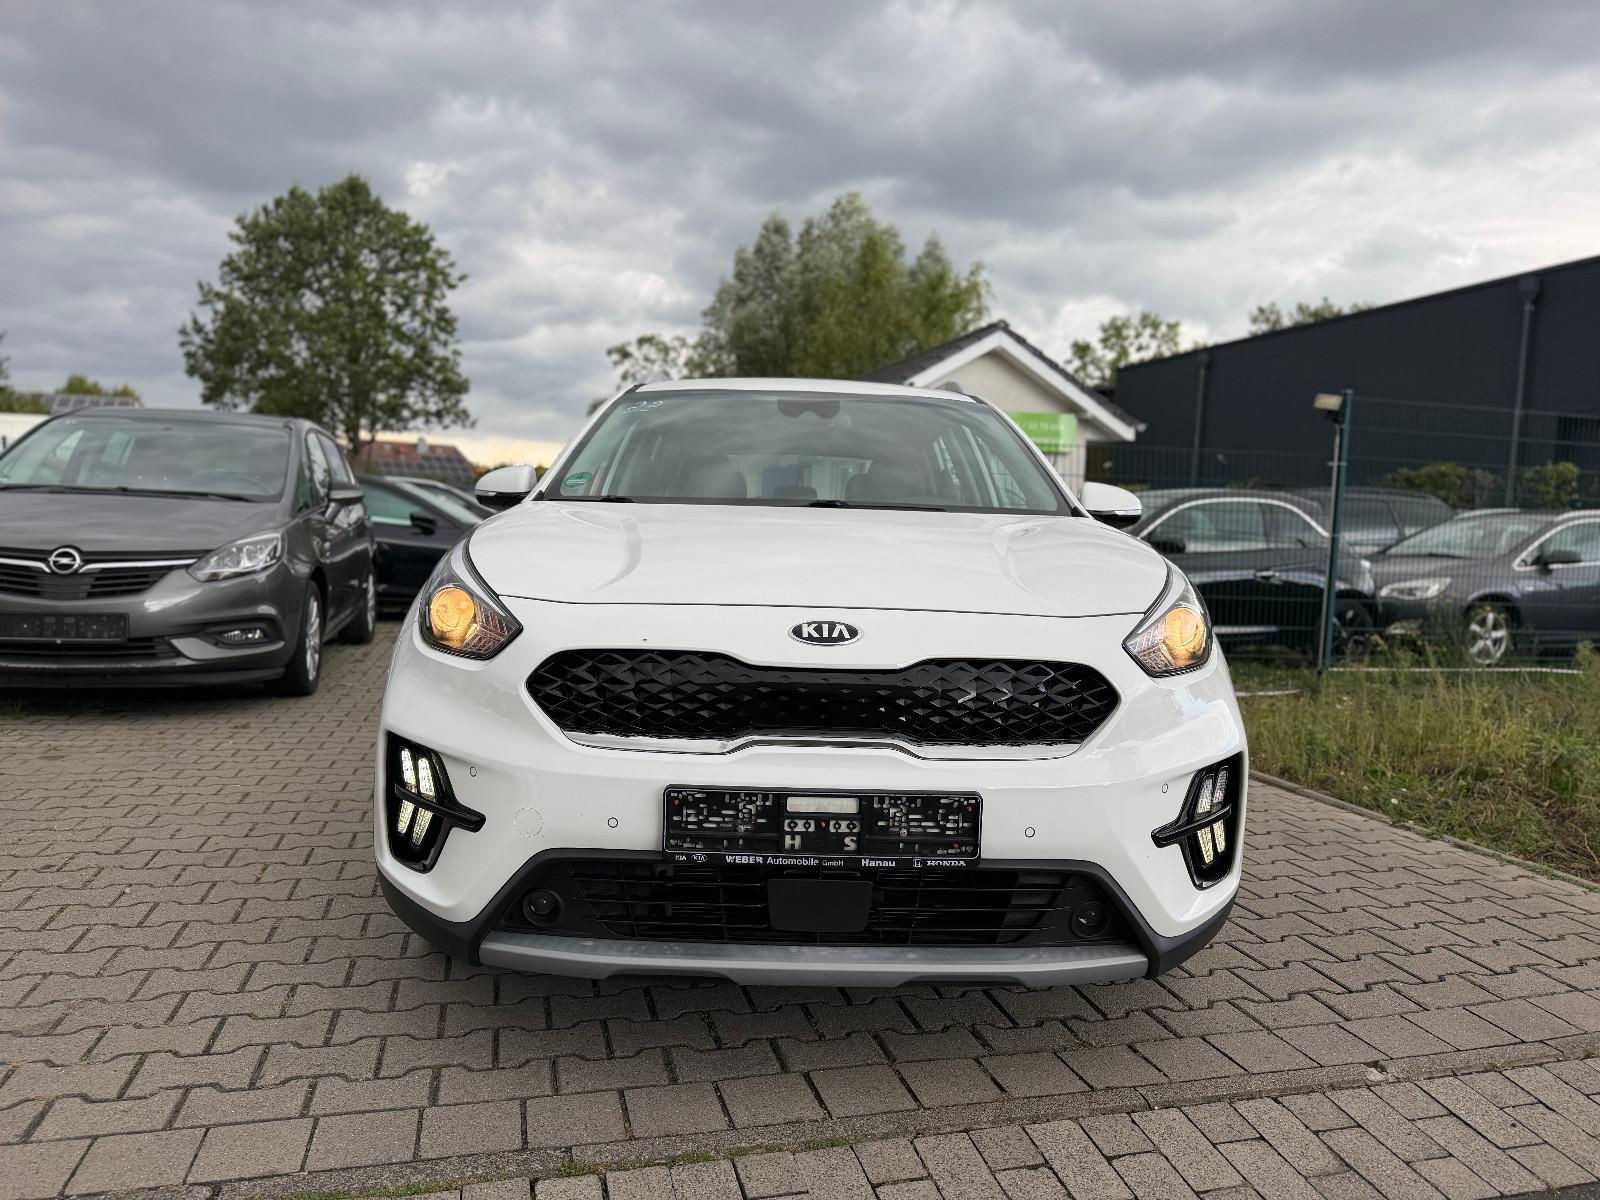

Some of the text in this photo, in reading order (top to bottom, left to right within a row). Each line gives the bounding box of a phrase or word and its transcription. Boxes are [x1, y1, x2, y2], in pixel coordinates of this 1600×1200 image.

[801, 623, 851, 639] KIA
[726, 855, 763, 864] WEBER
[767, 856, 819, 866] Automobile
[861, 858, 896, 867] Hanau
